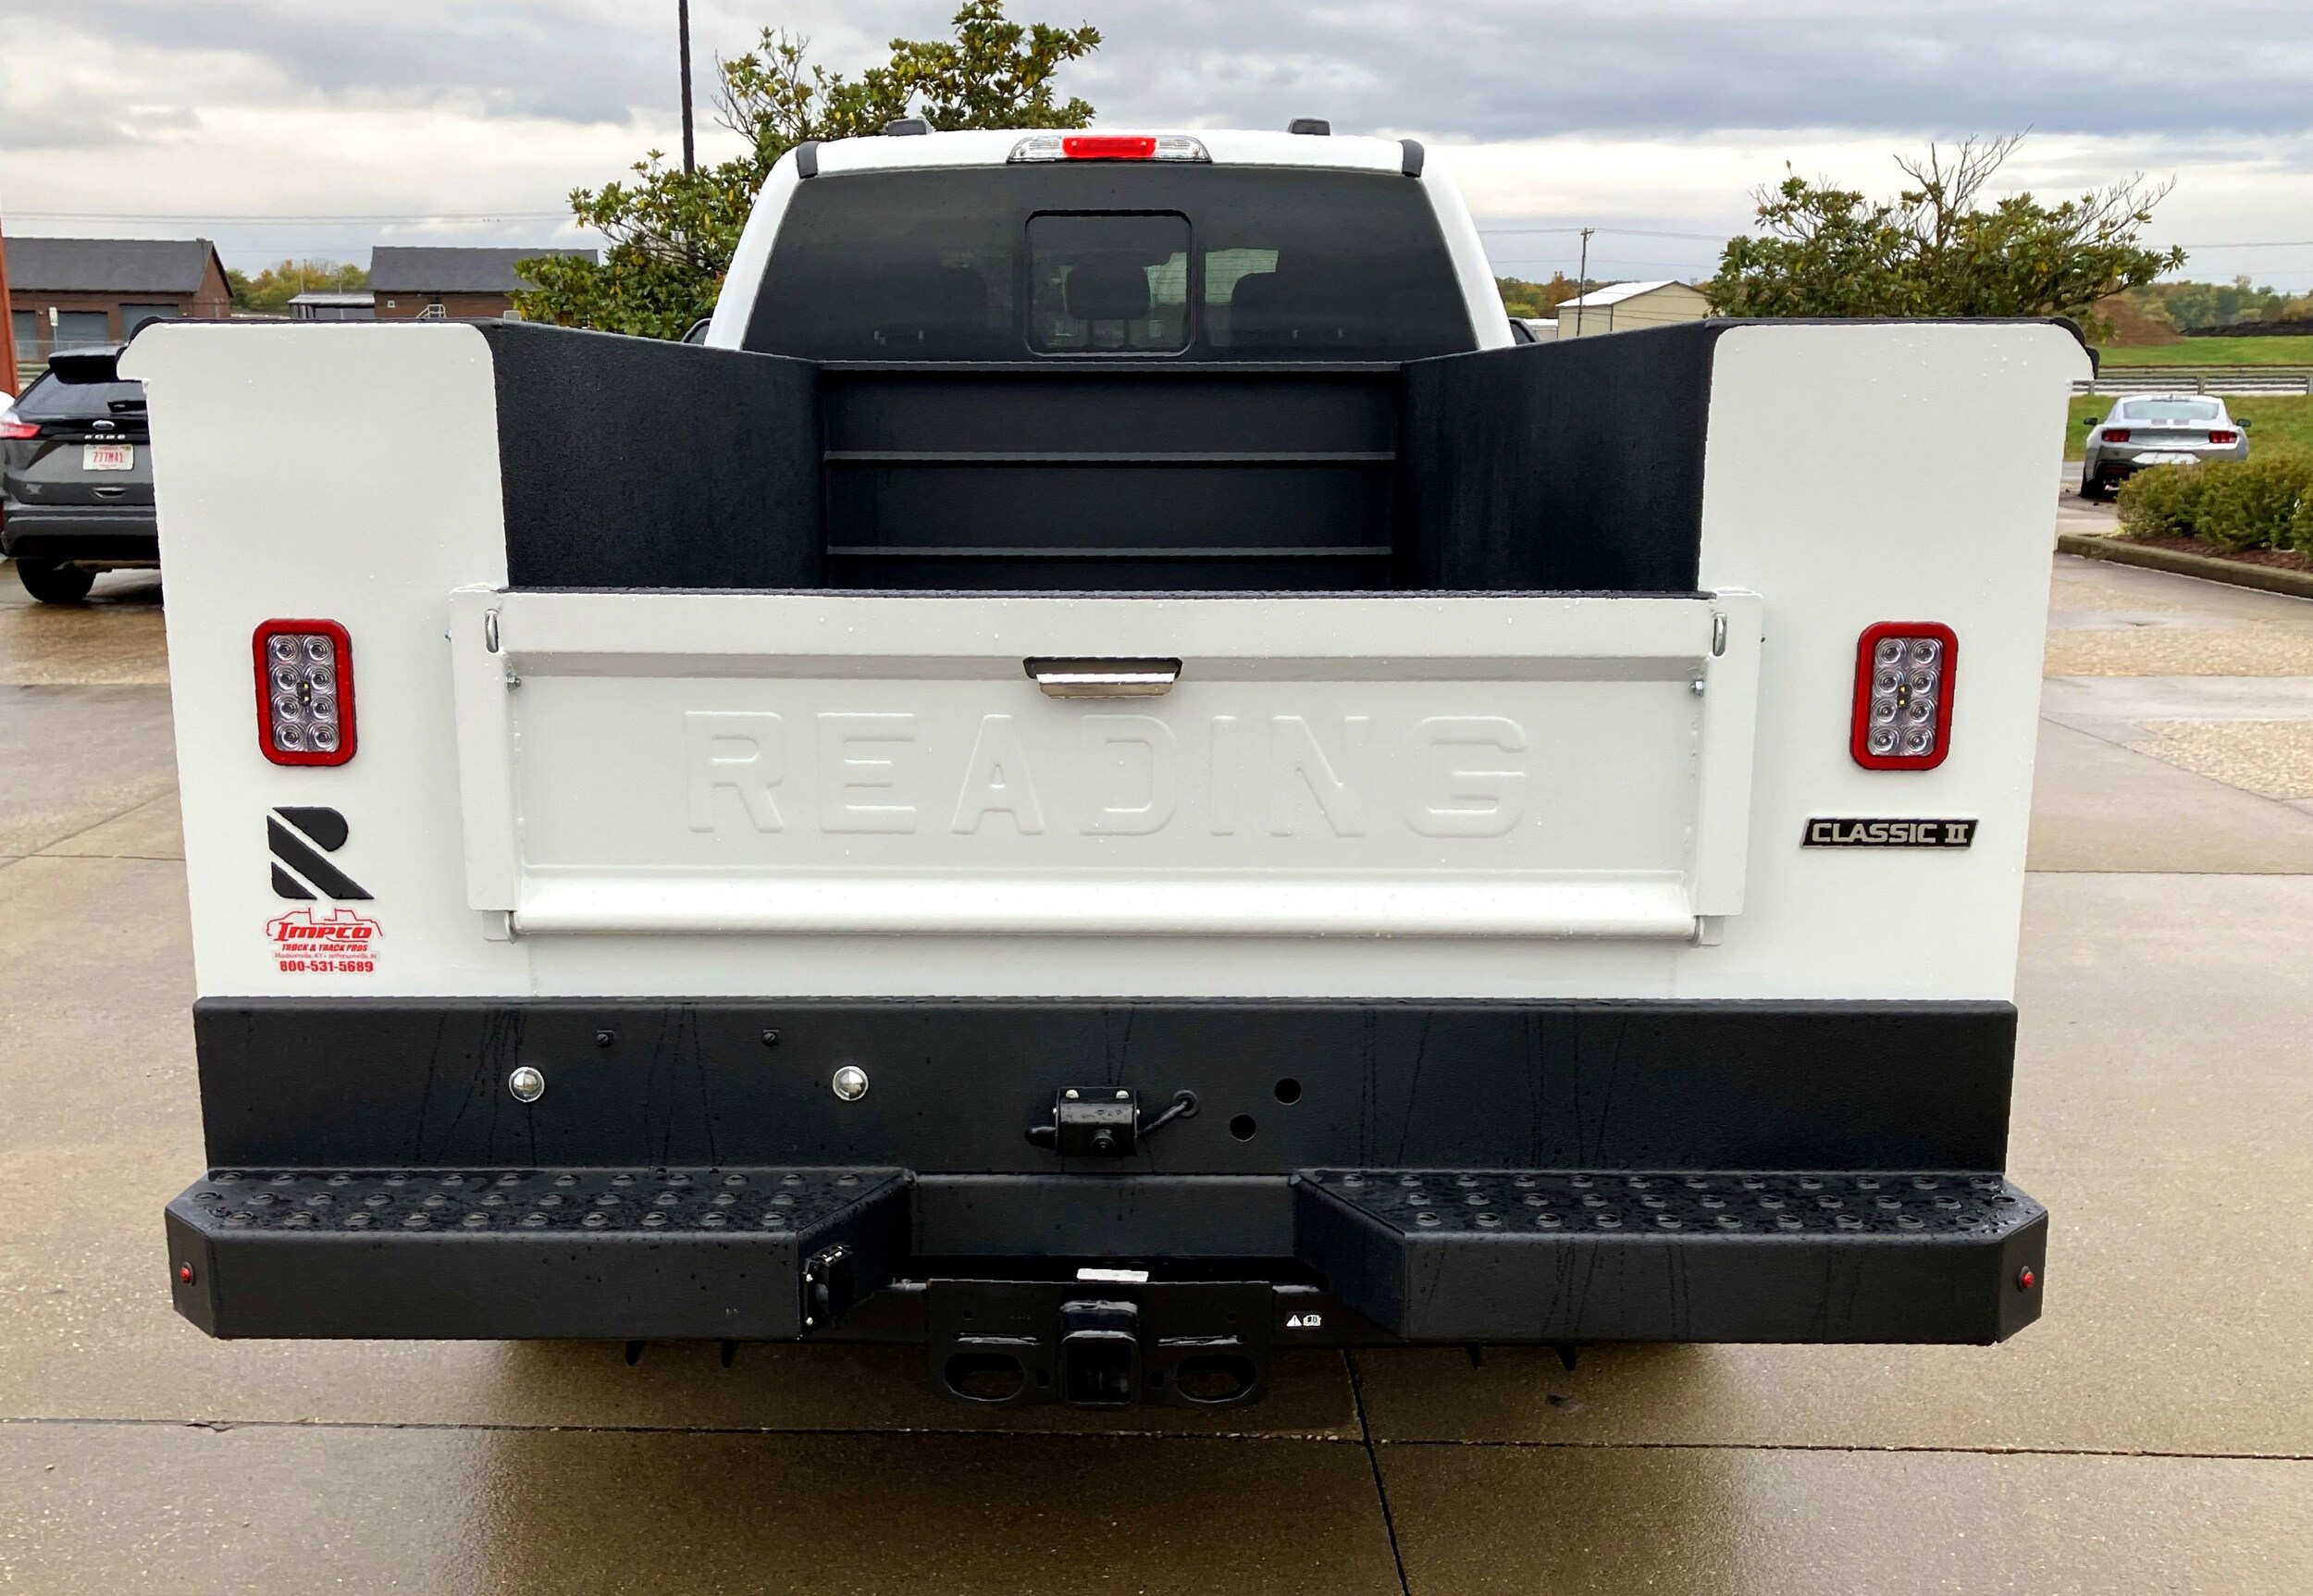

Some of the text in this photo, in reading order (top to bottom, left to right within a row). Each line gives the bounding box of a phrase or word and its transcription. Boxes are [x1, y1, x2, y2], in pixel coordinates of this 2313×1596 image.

[685, 710, 1528, 839] READING
[1812, 823, 1969, 844] CLASSIC II
[281, 944, 368, 952] TRUCK & TRACK PROS
[279, 960, 374, 972] 800-531-5689
